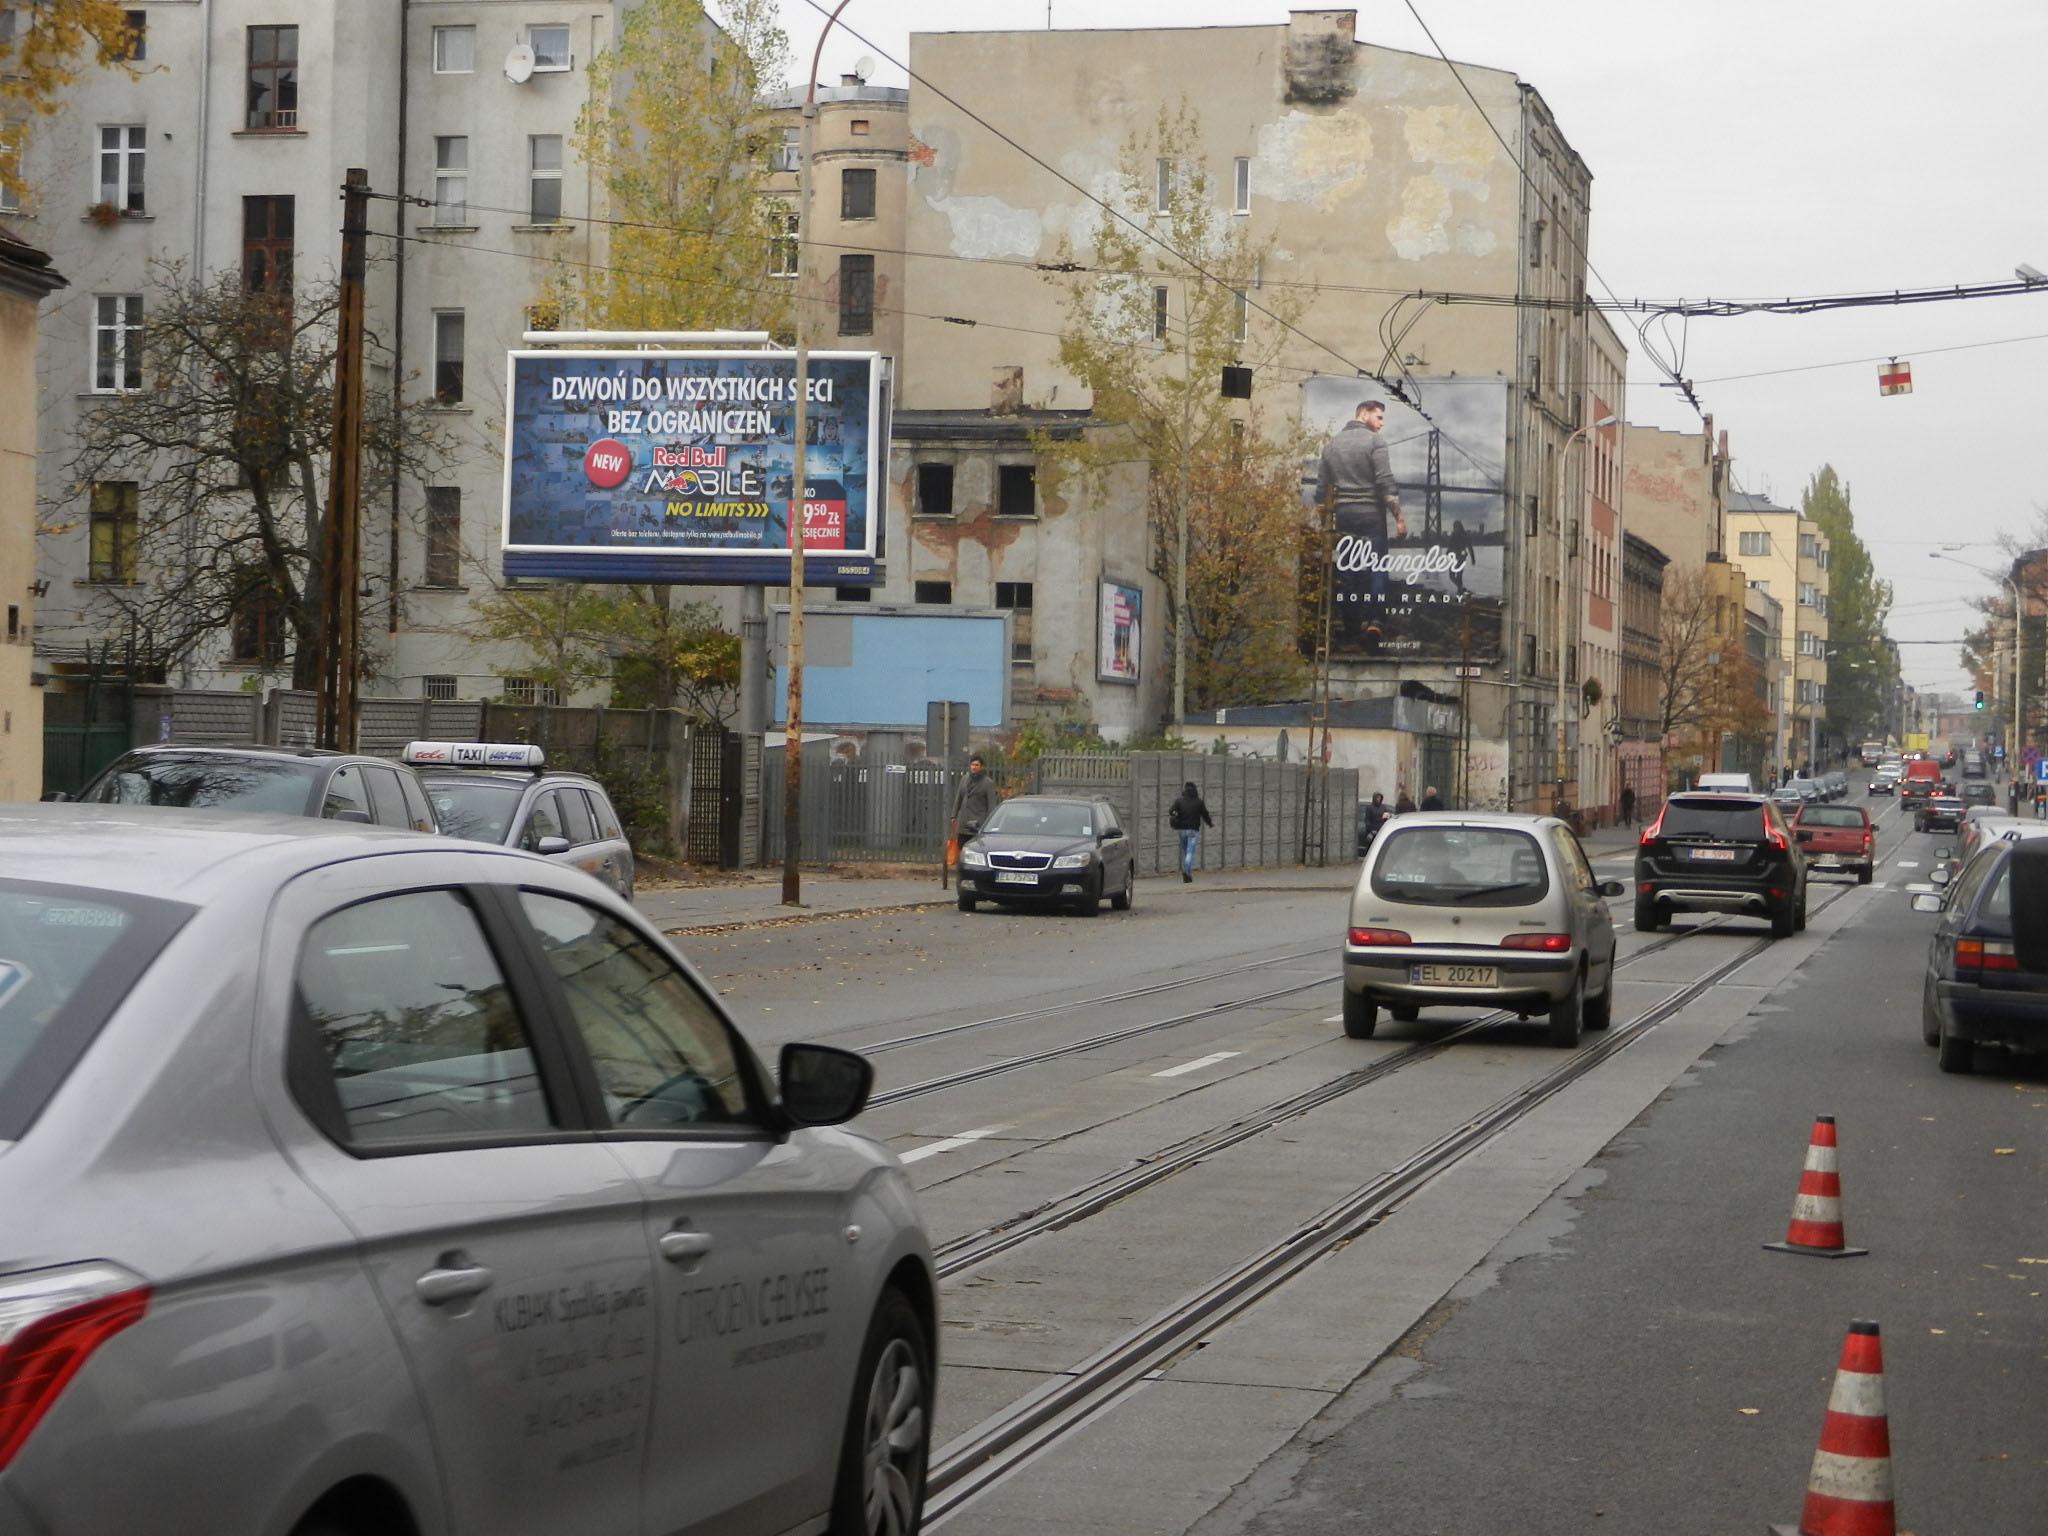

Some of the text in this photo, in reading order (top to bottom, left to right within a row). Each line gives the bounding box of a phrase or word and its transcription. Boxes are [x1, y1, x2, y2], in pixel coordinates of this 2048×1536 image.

[552, 371, 833, 403] DZWOŃ DO WSZYSTKICH SECI
[608, 404, 776, 435] BEZ OGRANICZEŃ.
[592, 453, 623, 473] NEW
[653, 446, 727, 467] Red Bull
[665, 502, 693, 517] NO
[827, 512, 841, 526] ZŁ
[1335, 535, 1467, 585] Wrangler
[1336, 593, 1464, 603] BORN READY
[1385, 607, 1413, 615] 1947
[457, 748, 482, 761] TAXI
[1421, 966, 1494, 982] EL 20217
